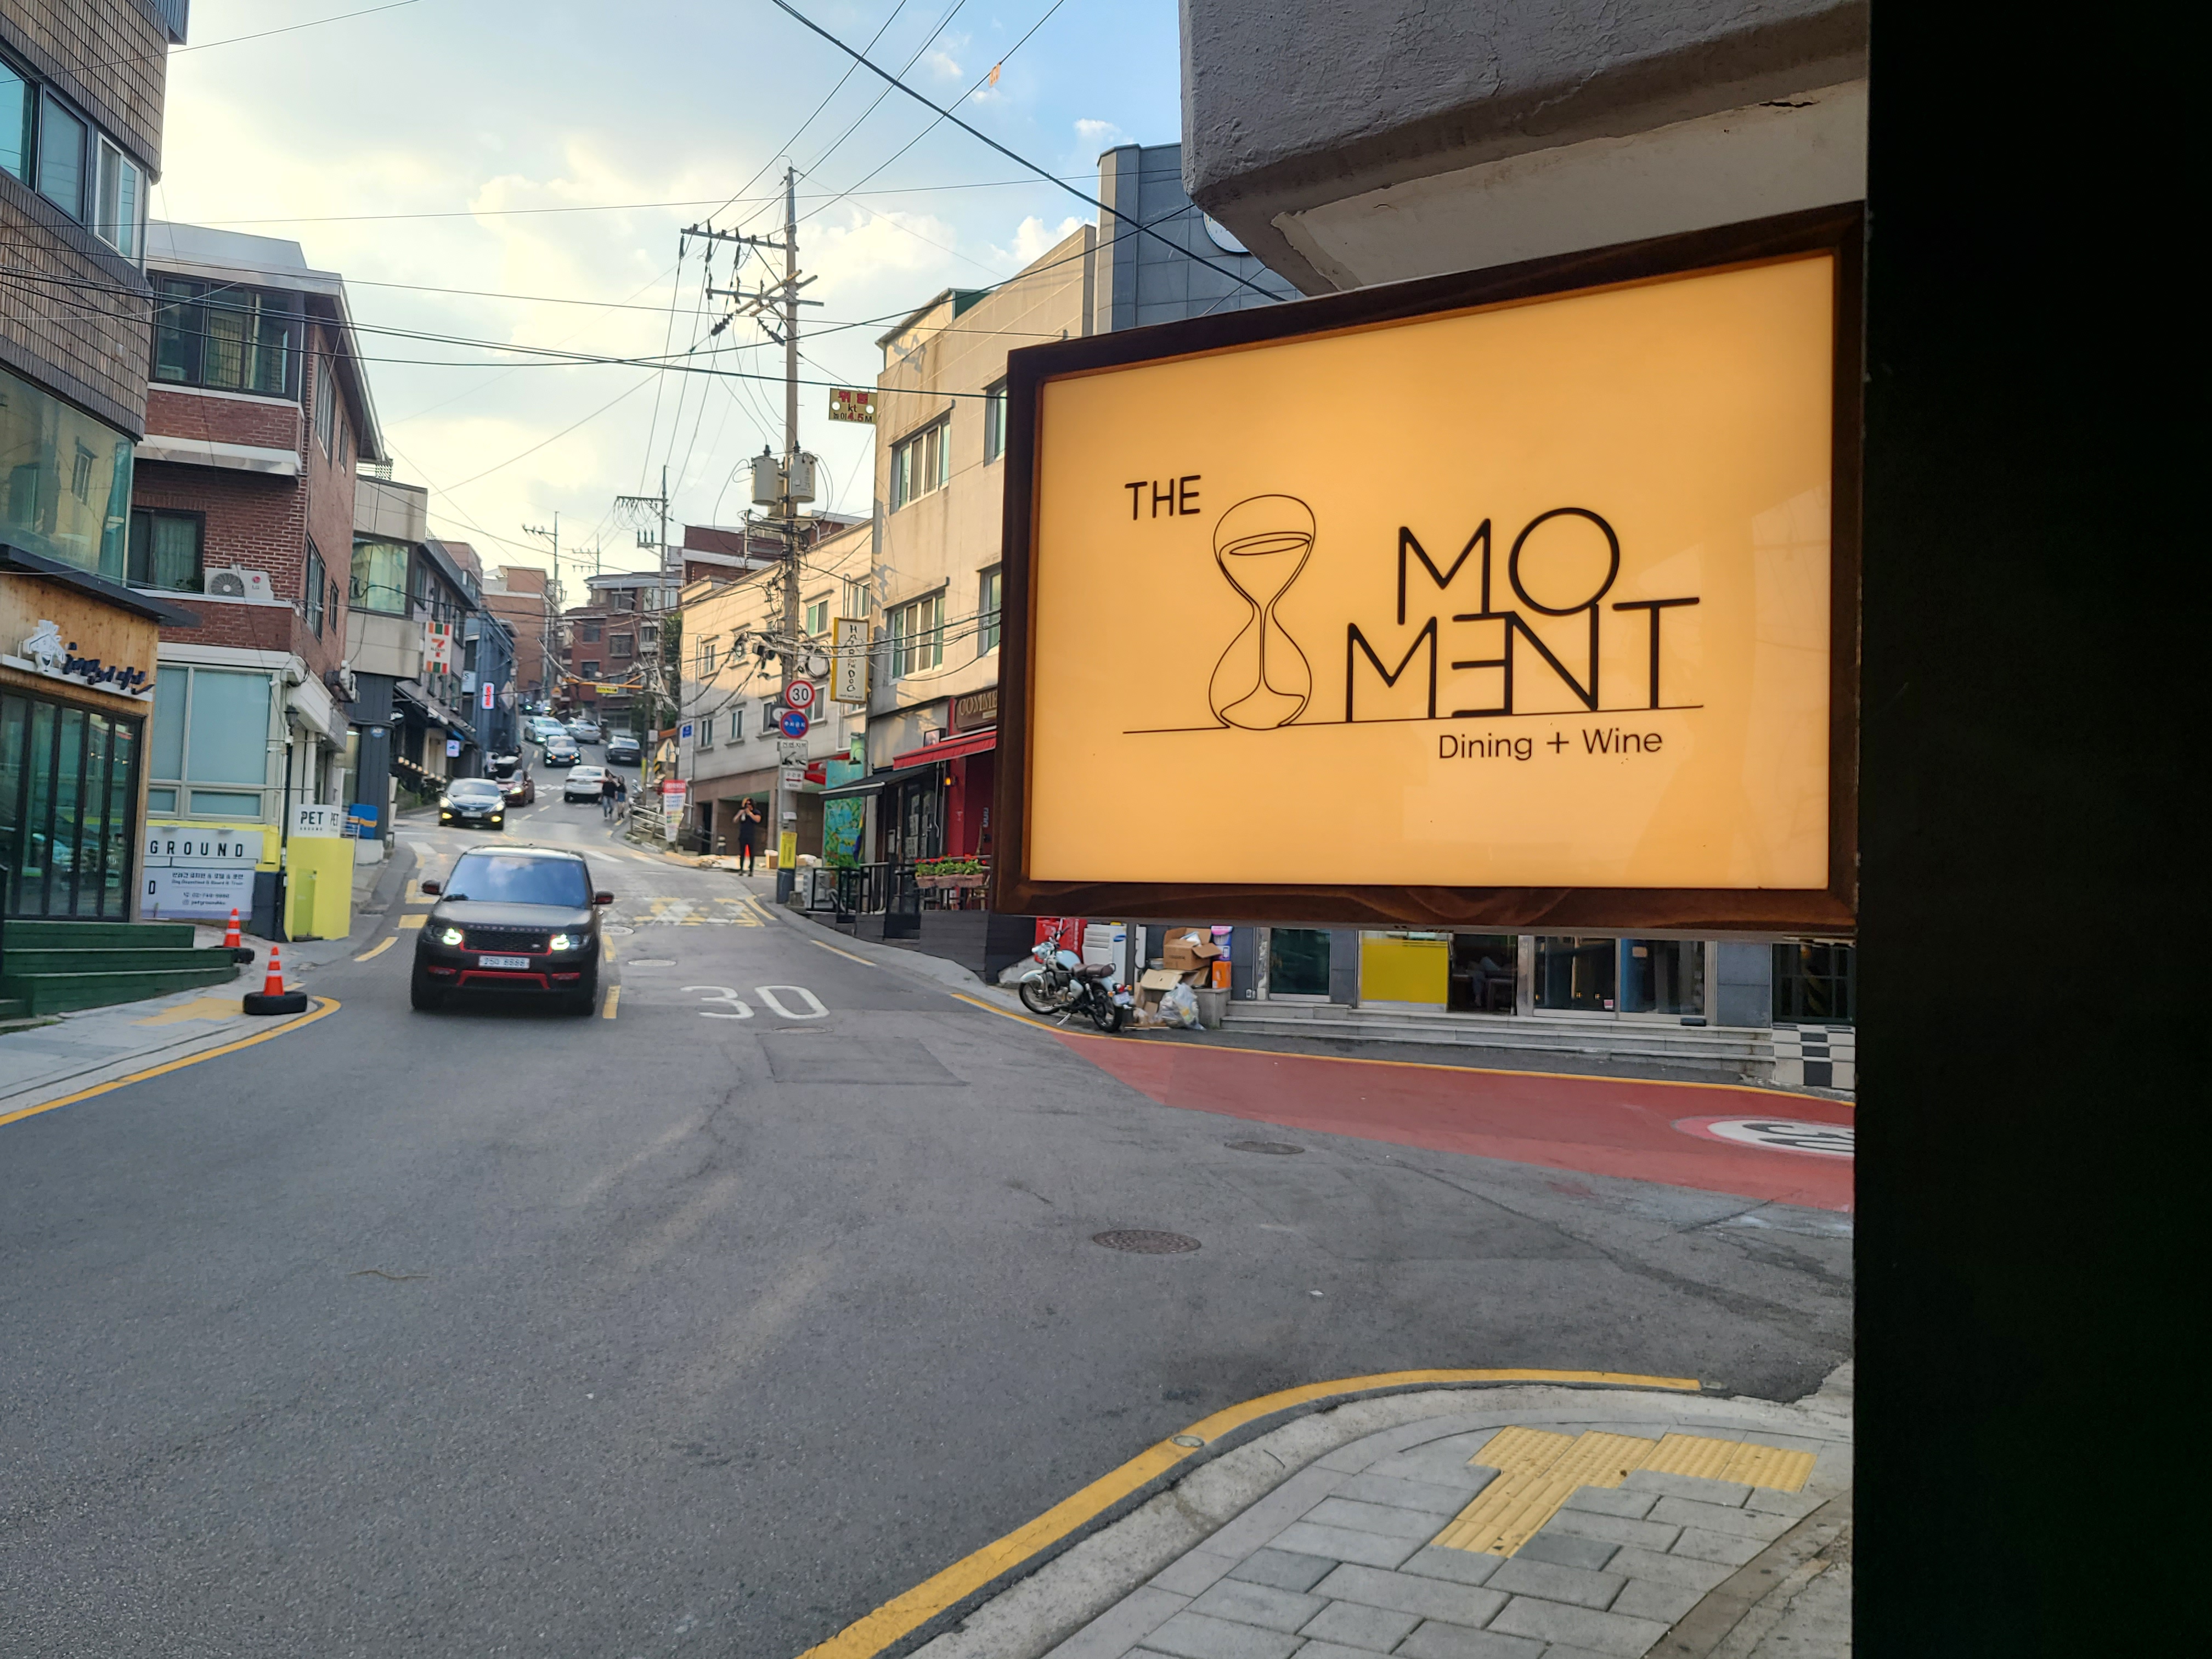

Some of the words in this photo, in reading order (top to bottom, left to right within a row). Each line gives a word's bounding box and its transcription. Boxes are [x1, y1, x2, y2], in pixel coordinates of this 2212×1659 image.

[848, 403, 857, 413] kt
[1125, 475, 1201, 520] THE
[793, 688, 809, 701] 30
[1438, 732, 1533, 761] Dining
[1546, 731, 1570, 755] +
[1582, 727, 1663, 755] Wine
[300, 811, 324, 825] PET
[150, 840, 243, 857] GROUND
[680, 985, 830, 1019] 30
